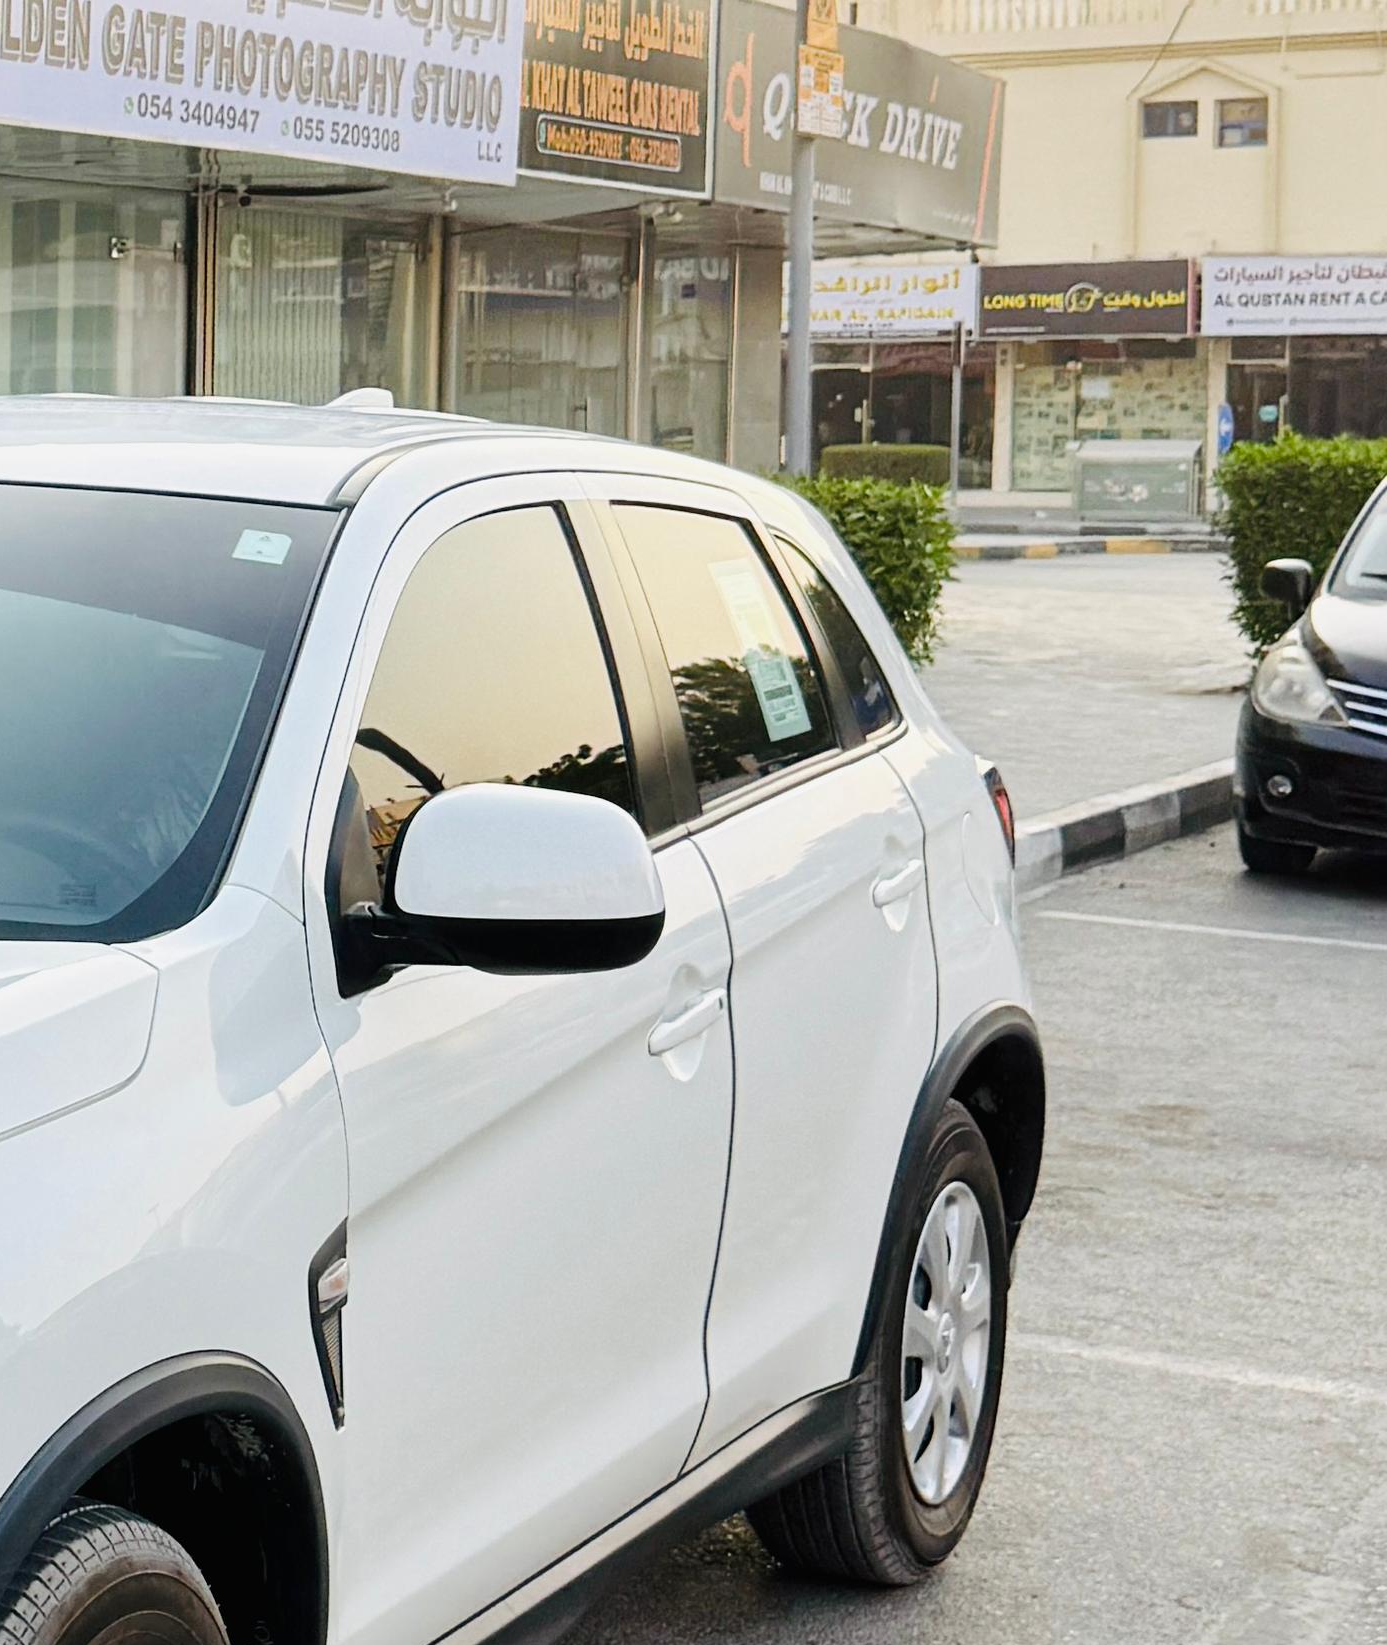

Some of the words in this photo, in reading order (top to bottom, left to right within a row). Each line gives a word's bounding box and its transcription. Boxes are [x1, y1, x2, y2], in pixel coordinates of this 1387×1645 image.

[102, 3, 187, 85] GATE
[193, 20, 406, 118] PHOTOGRAPHY
[411, 60, 503, 134] STUDIO
[137, 92, 173, 121] 054
[179, 99, 260, 135] 3404947
[293, 116, 324, 143] 055
[330, 125, 400, 153] 5209308
[476, 139, 503, 163] LLC
[879, 102, 963, 170] DRIVE
[983, 294, 1026, 310] LONG
[1028, 292, 1065, 310] TIME
[1213, 293, 1235, 307] AL
[1308, 291, 1352, 307] RENT
[1354, 291, 1366, 305] A
